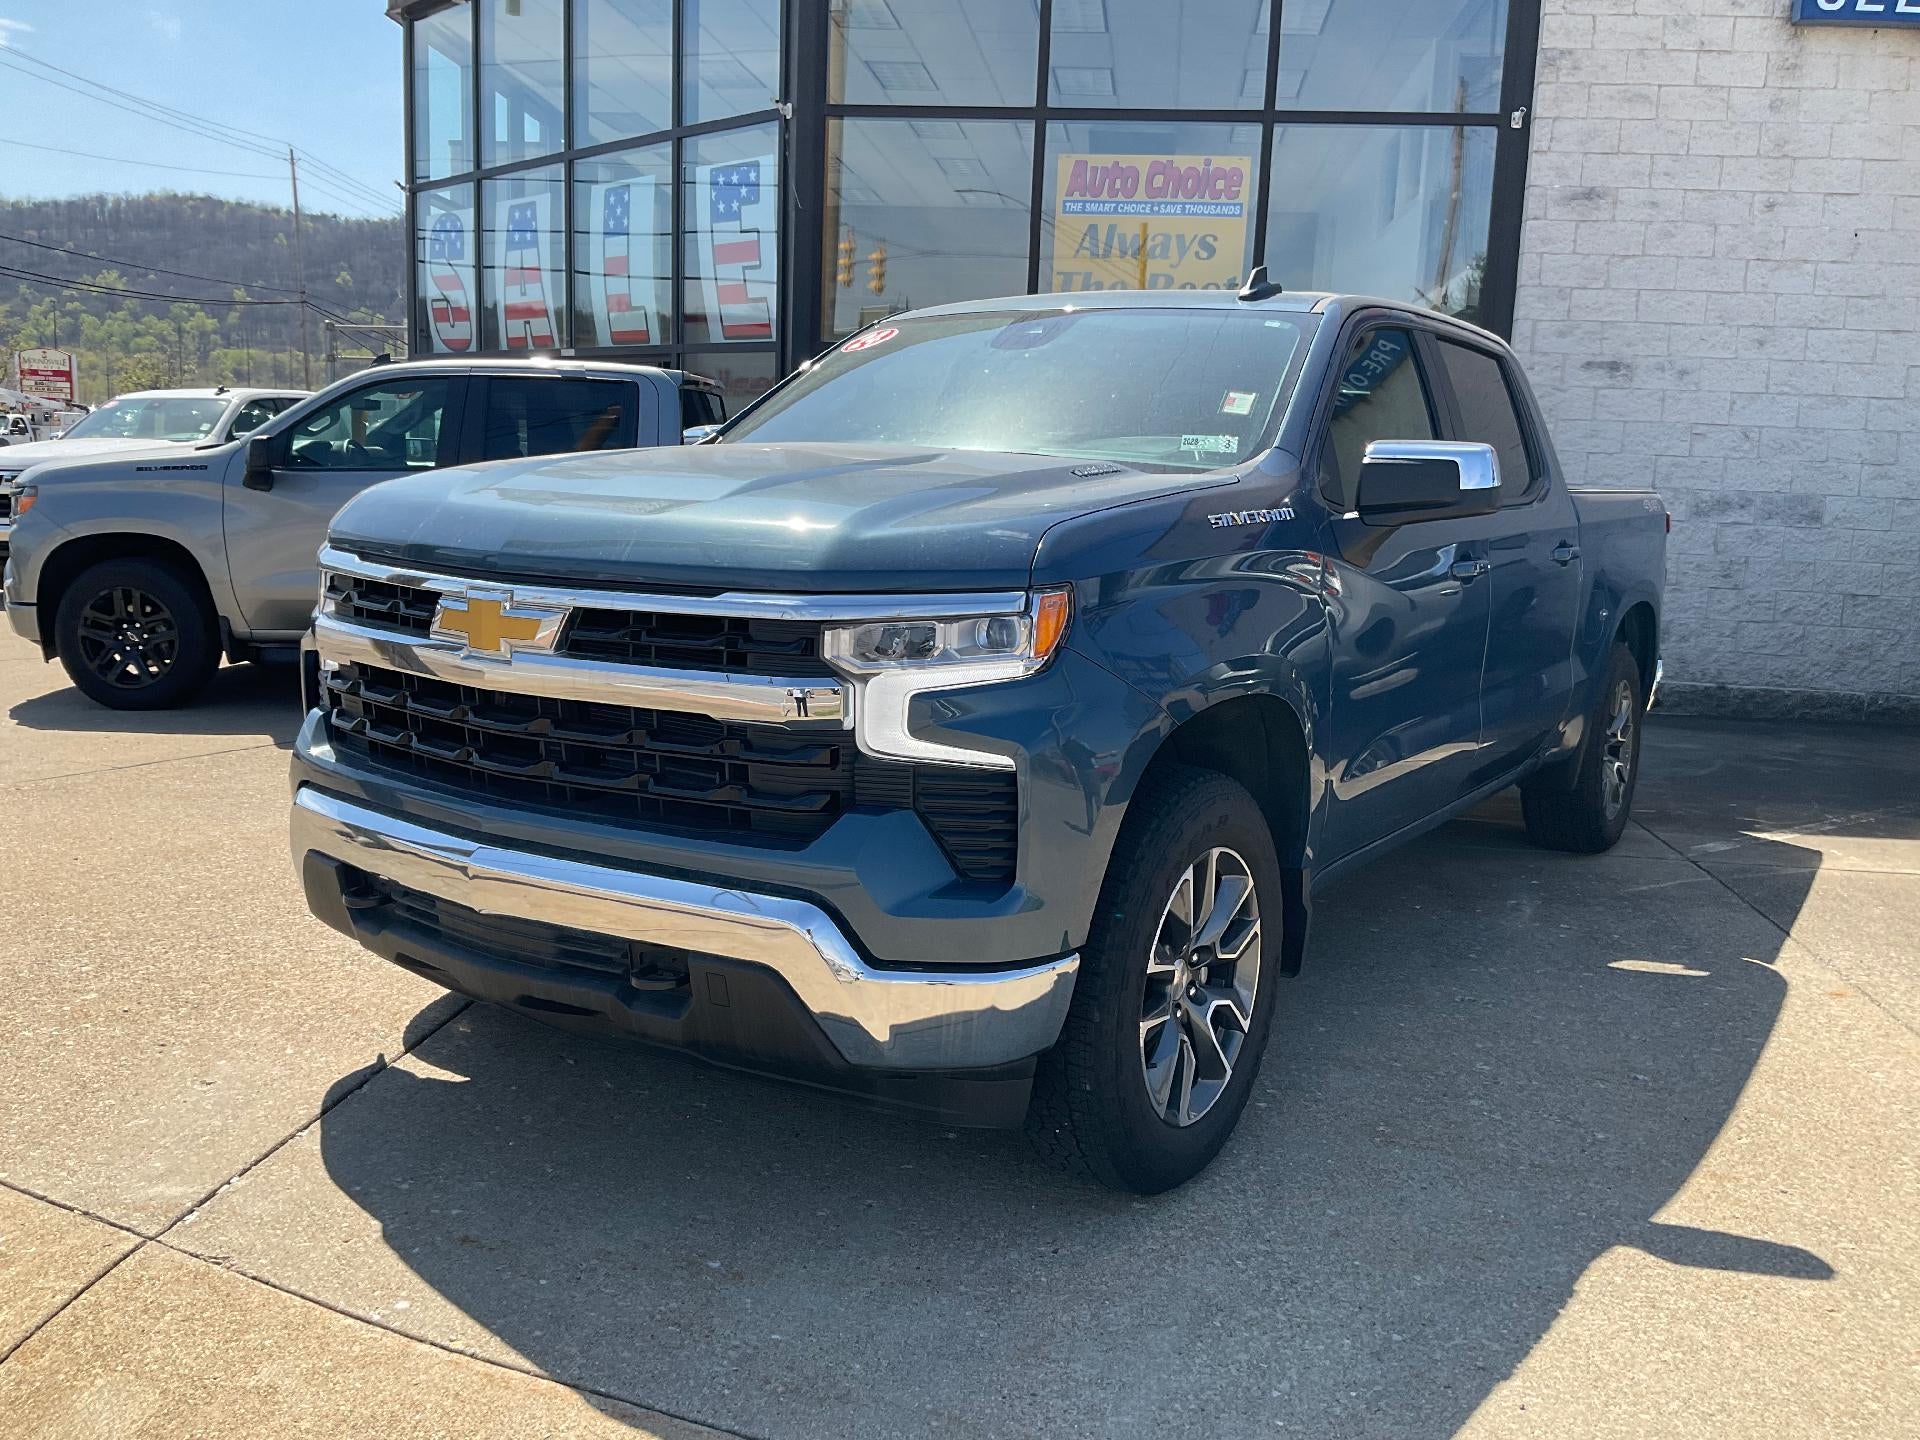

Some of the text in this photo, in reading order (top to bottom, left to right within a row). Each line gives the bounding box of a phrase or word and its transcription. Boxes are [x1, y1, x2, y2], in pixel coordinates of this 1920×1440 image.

[1065, 158, 1244, 200] Auto Choice
[1065, 202, 1241, 215] THE SMART CHOICE SAVE THOUSANDS
[1072, 223, 1219, 269] Always
[1207, 507, 1295, 529] SILVERADO
